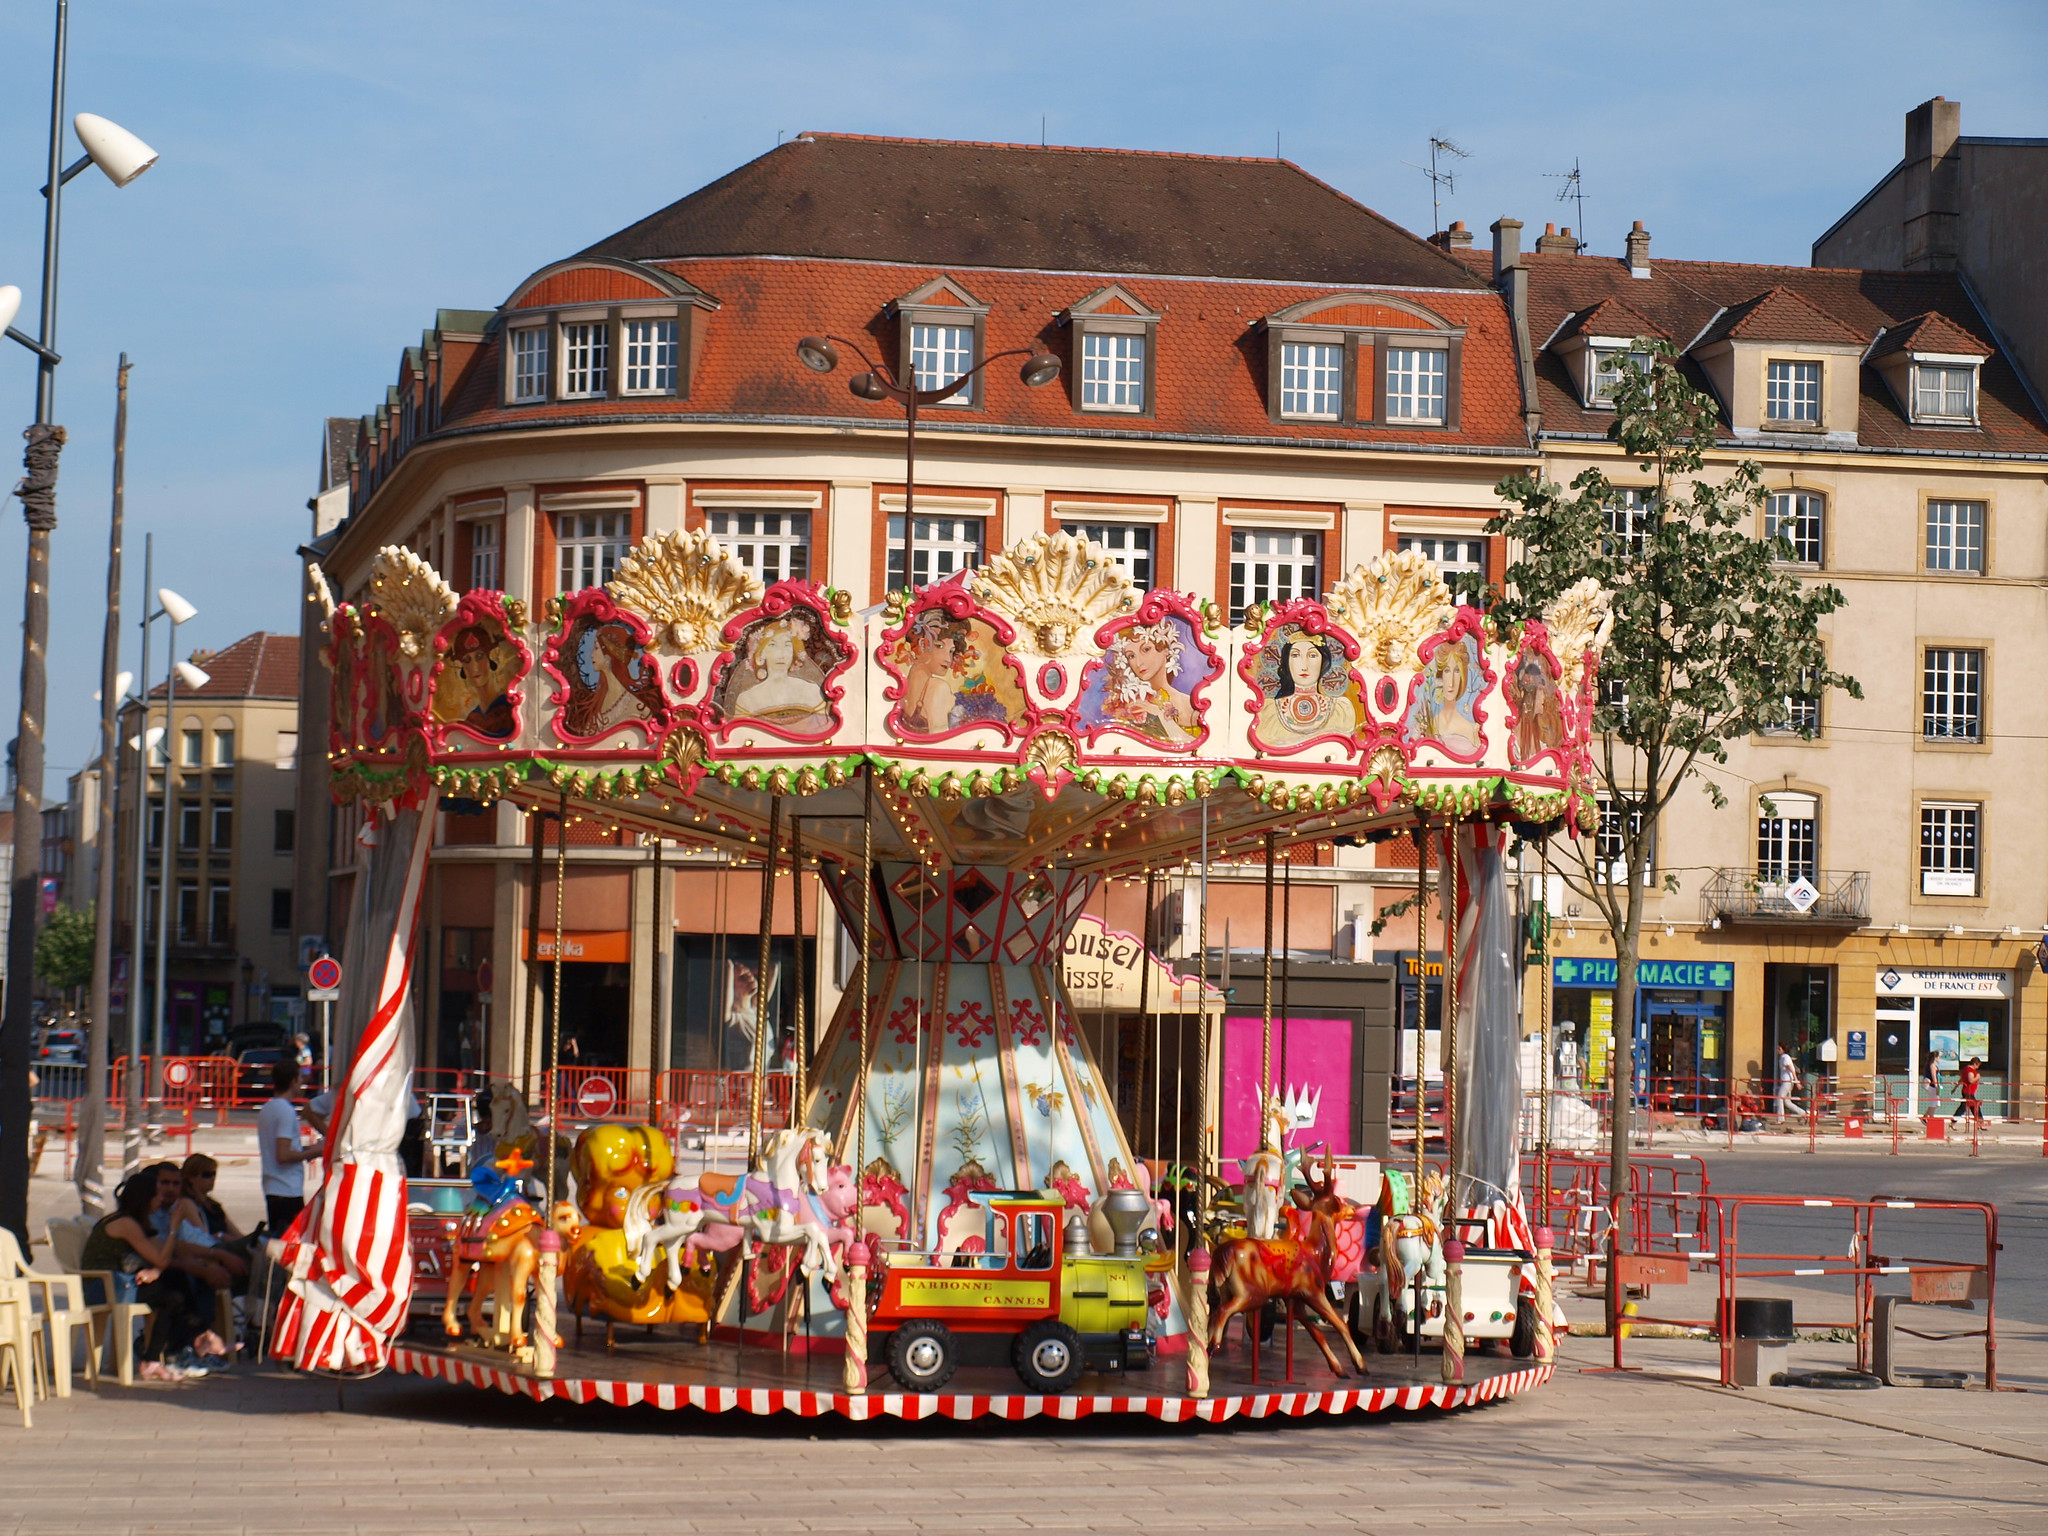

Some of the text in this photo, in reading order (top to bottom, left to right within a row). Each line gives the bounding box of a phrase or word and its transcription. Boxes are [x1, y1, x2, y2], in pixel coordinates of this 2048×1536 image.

[1582, 961, 1706, 985] PHAMACIE
[1911, 970, 2007, 981] CREDIT IMMOBILIER
[1924, 981, 1994, 991] DE FRANCE EST
[905, 1280, 993, 1291] NARBONNE
[983, 1295, 1046, 1305] CANNES
